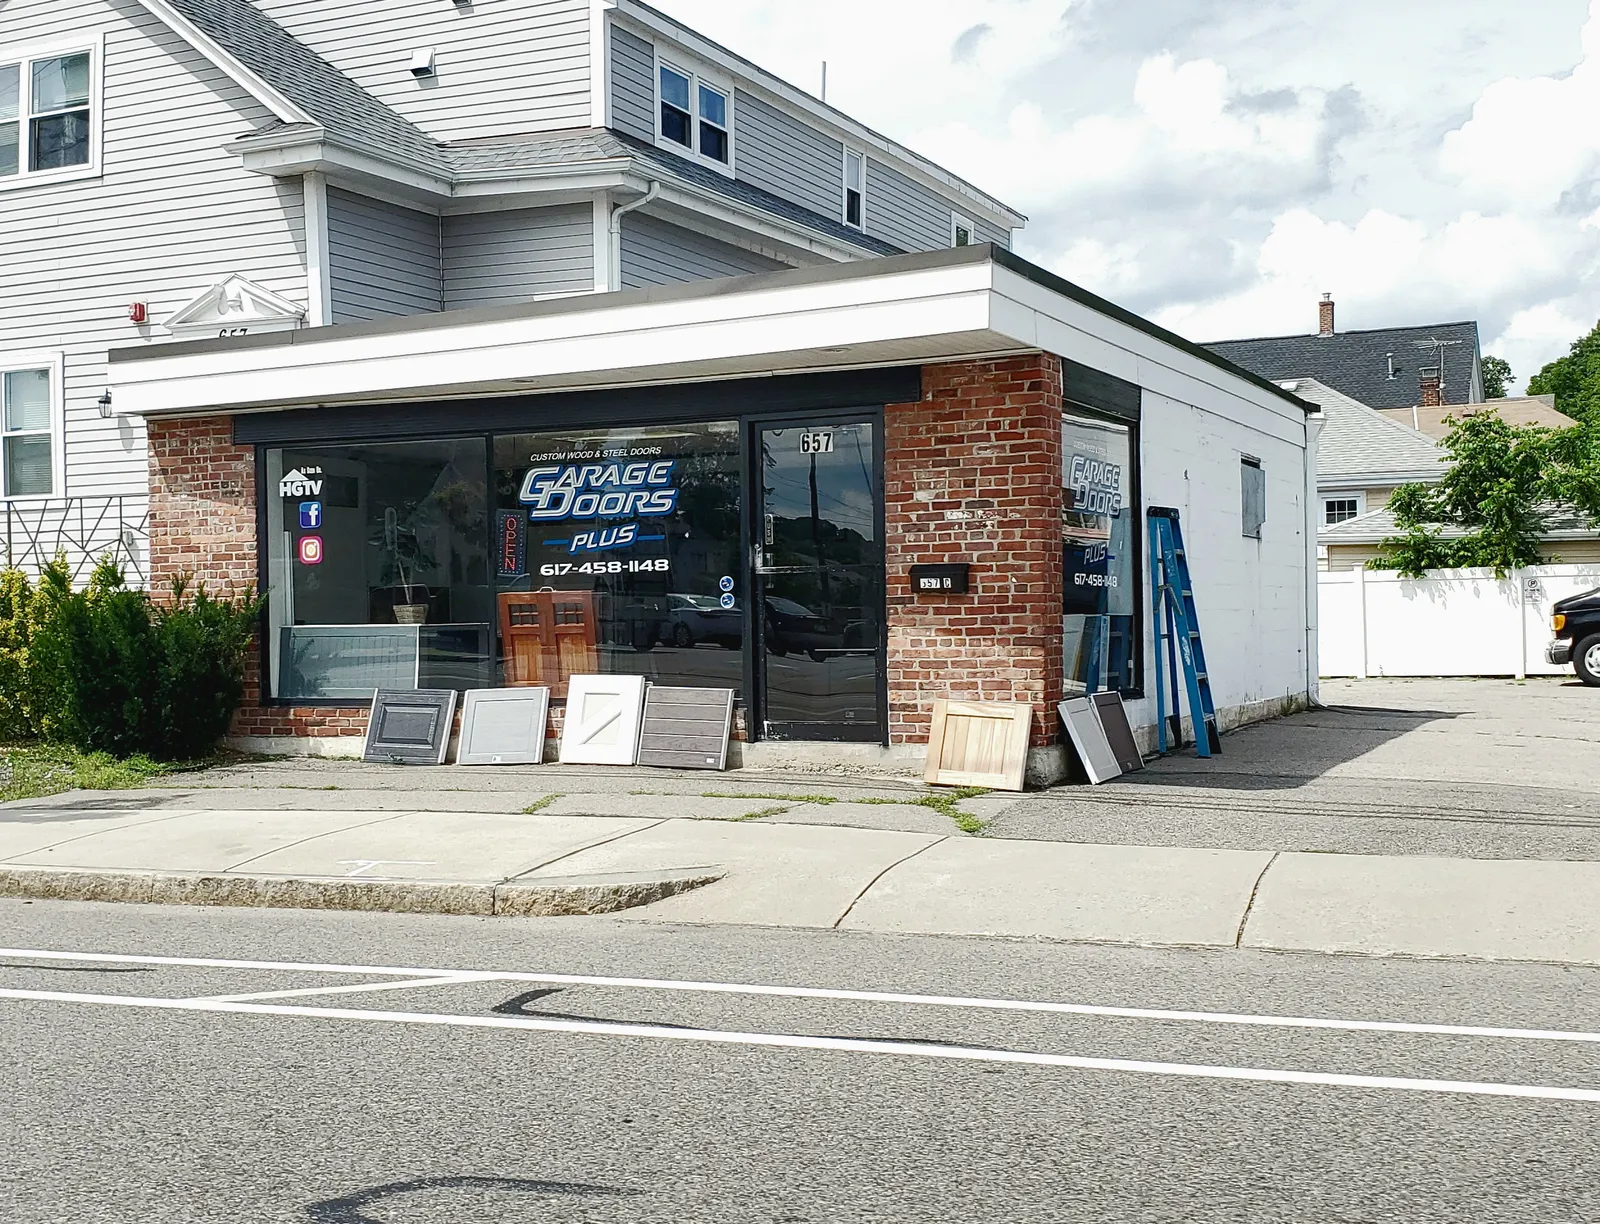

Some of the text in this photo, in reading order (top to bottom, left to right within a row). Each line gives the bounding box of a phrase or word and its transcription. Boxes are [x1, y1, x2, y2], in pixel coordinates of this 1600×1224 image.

[530, 446, 662, 462] CUSTOM WOOD & STEEL DOORS
[801, 432, 832, 452] 657
[518, 460, 675, 508] GARAGE
[1070, 455, 1120, 490] GARAGE
[279, 480, 322, 497] HGTV
[530, 487, 677, 518] DOORS
[1074, 480, 1121, 517] DOORS
[504, 517, 517, 571] OPEN
[569, 524, 637, 553] PLUS
[540, 558, 669, 576] 617-458-1148
[1084, 544, 1106, 565] PLUS
